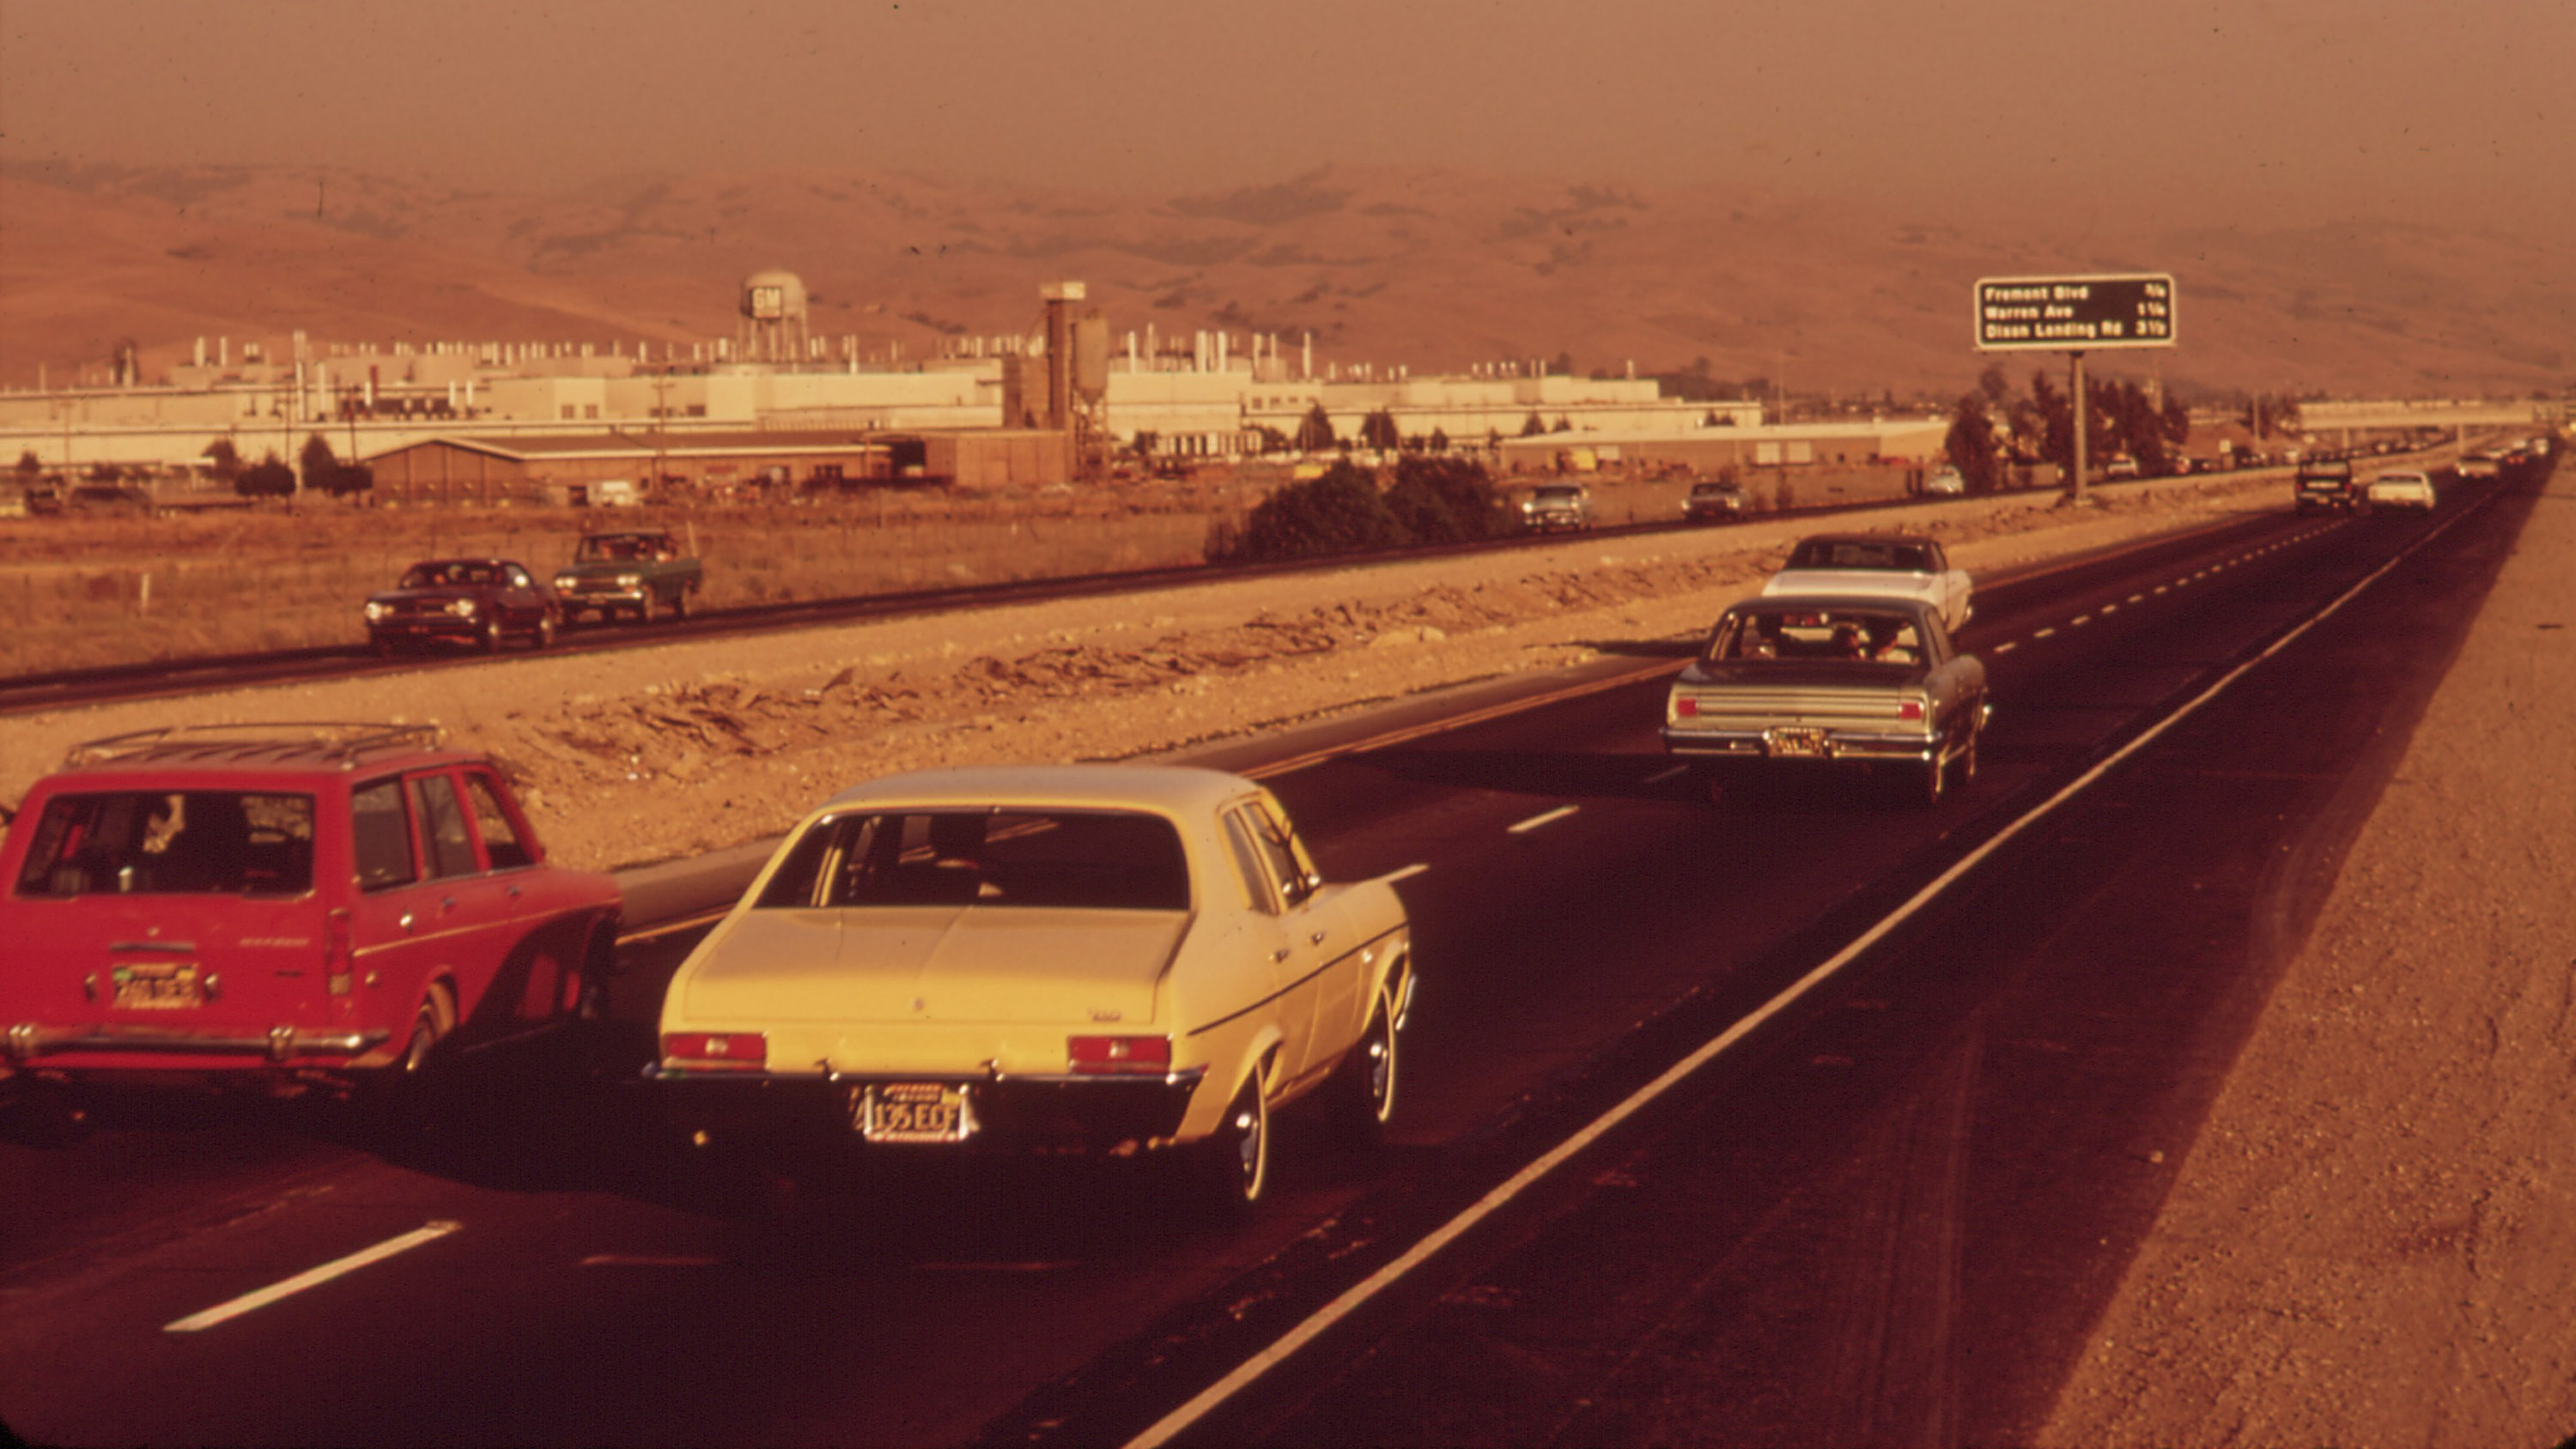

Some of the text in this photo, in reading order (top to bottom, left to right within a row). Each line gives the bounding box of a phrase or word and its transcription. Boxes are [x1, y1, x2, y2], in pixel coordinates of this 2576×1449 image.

[753, 288, 780, 308] GM
[1985, 287, 2048, 302] Fremont
[2054, 285, 2088, 300] Blvd
[1985, 306, 2039, 320] Warren
[2044, 304, 2074, 318] Ave
[1986, 323, 2029, 339] Dixon
[2035, 322, 2096, 339] Landing
[2101, 319, 2122, 336] Rd
